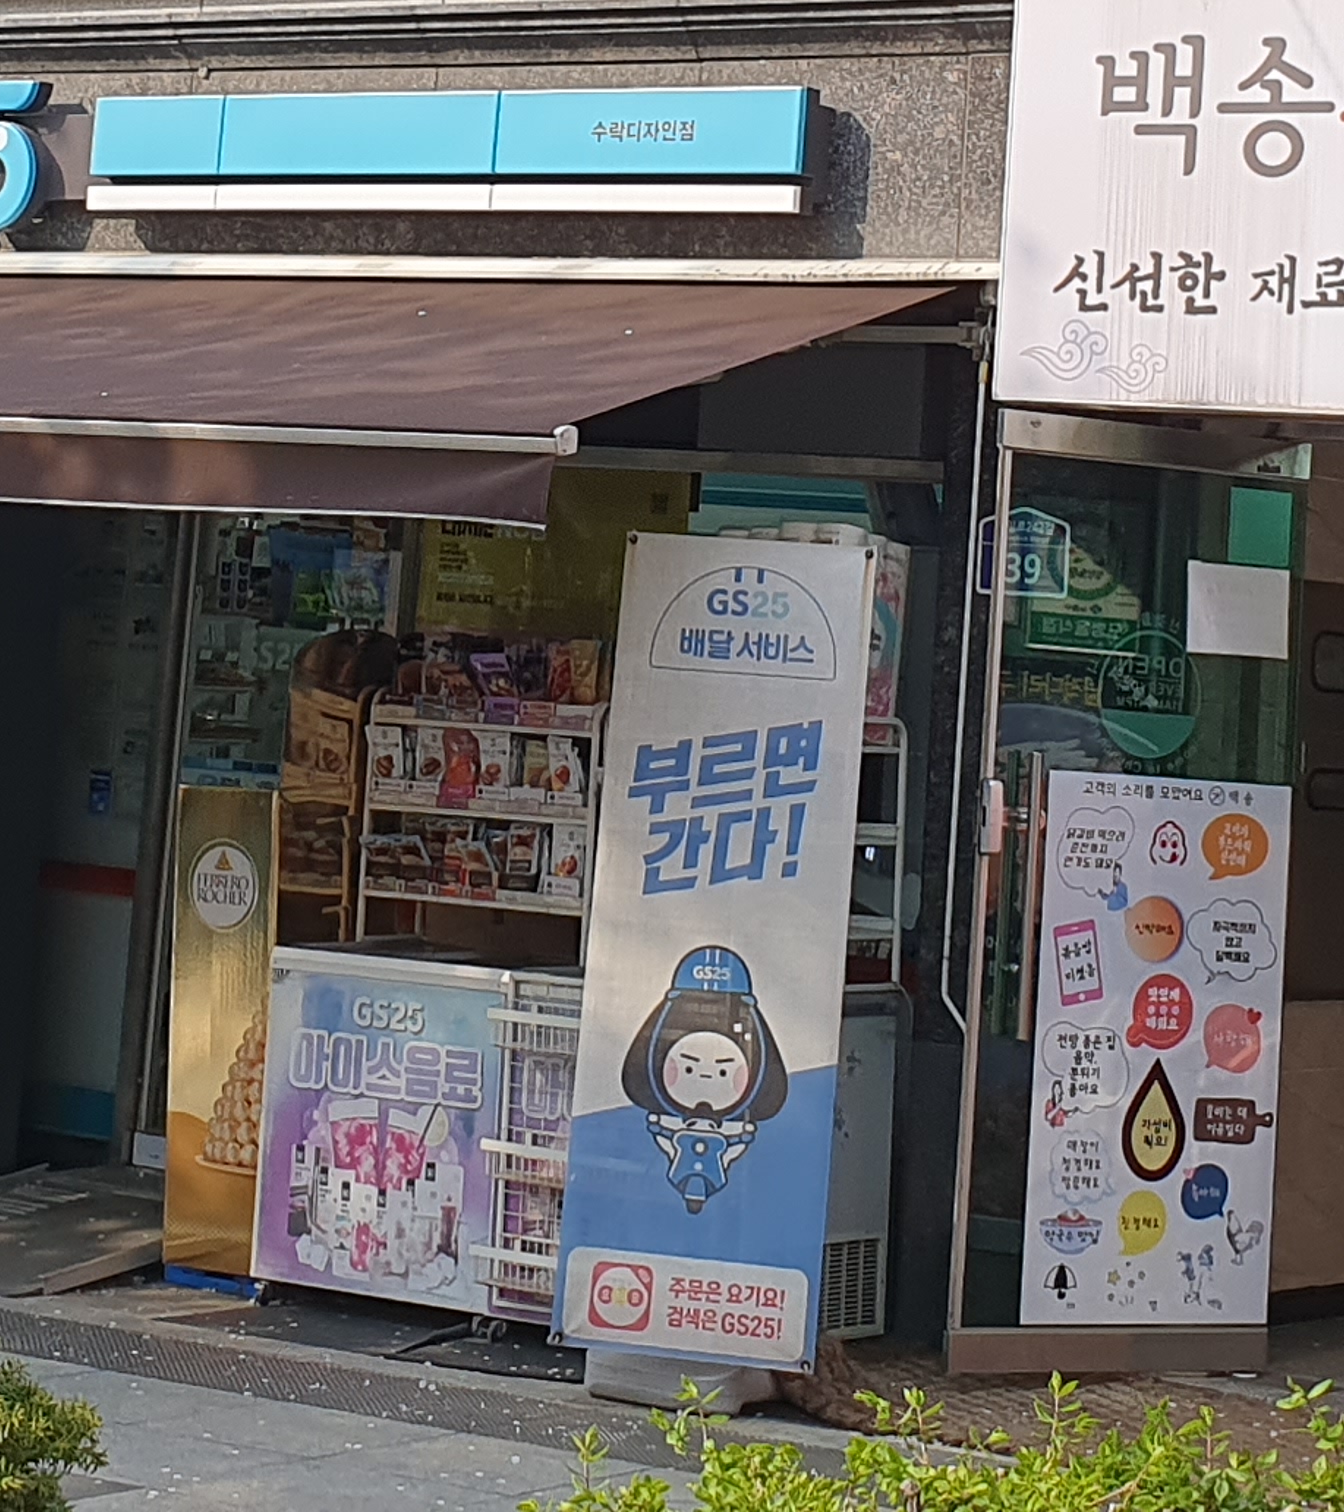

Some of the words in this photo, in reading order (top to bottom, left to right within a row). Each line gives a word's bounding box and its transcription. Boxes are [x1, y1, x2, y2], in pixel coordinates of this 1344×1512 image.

[591, 119, 697, 144] 수락디자인점
[1053, 248, 1227, 319] 신선한
[1005, 551, 1042, 585] 39
[705, 588, 791, 620] GS25
[678, 627, 734, 660] 배달
[735, 632, 815, 665] 서비스
[627, 719, 824, 815] 부르면
[1082, 780, 1117, 798] 고객의
[1122, 782, 1155, 800] 소리를
[641, 802, 807, 896] 간다!
[196, 889, 249, 908] ROCHER
[197, 872, 249, 890] FERRERO
[692, 965, 732, 981] GS25
[352, 995, 425, 1035] GS25
[288, 1027, 485, 1110] 아이스음료
[667, 1276, 723, 1306] 주문은
[725, 1282, 786, 1311] 요기요!
[665, 1304, 718, 1331] 검색은
[720, 1309, 783, 1341] GS25!
